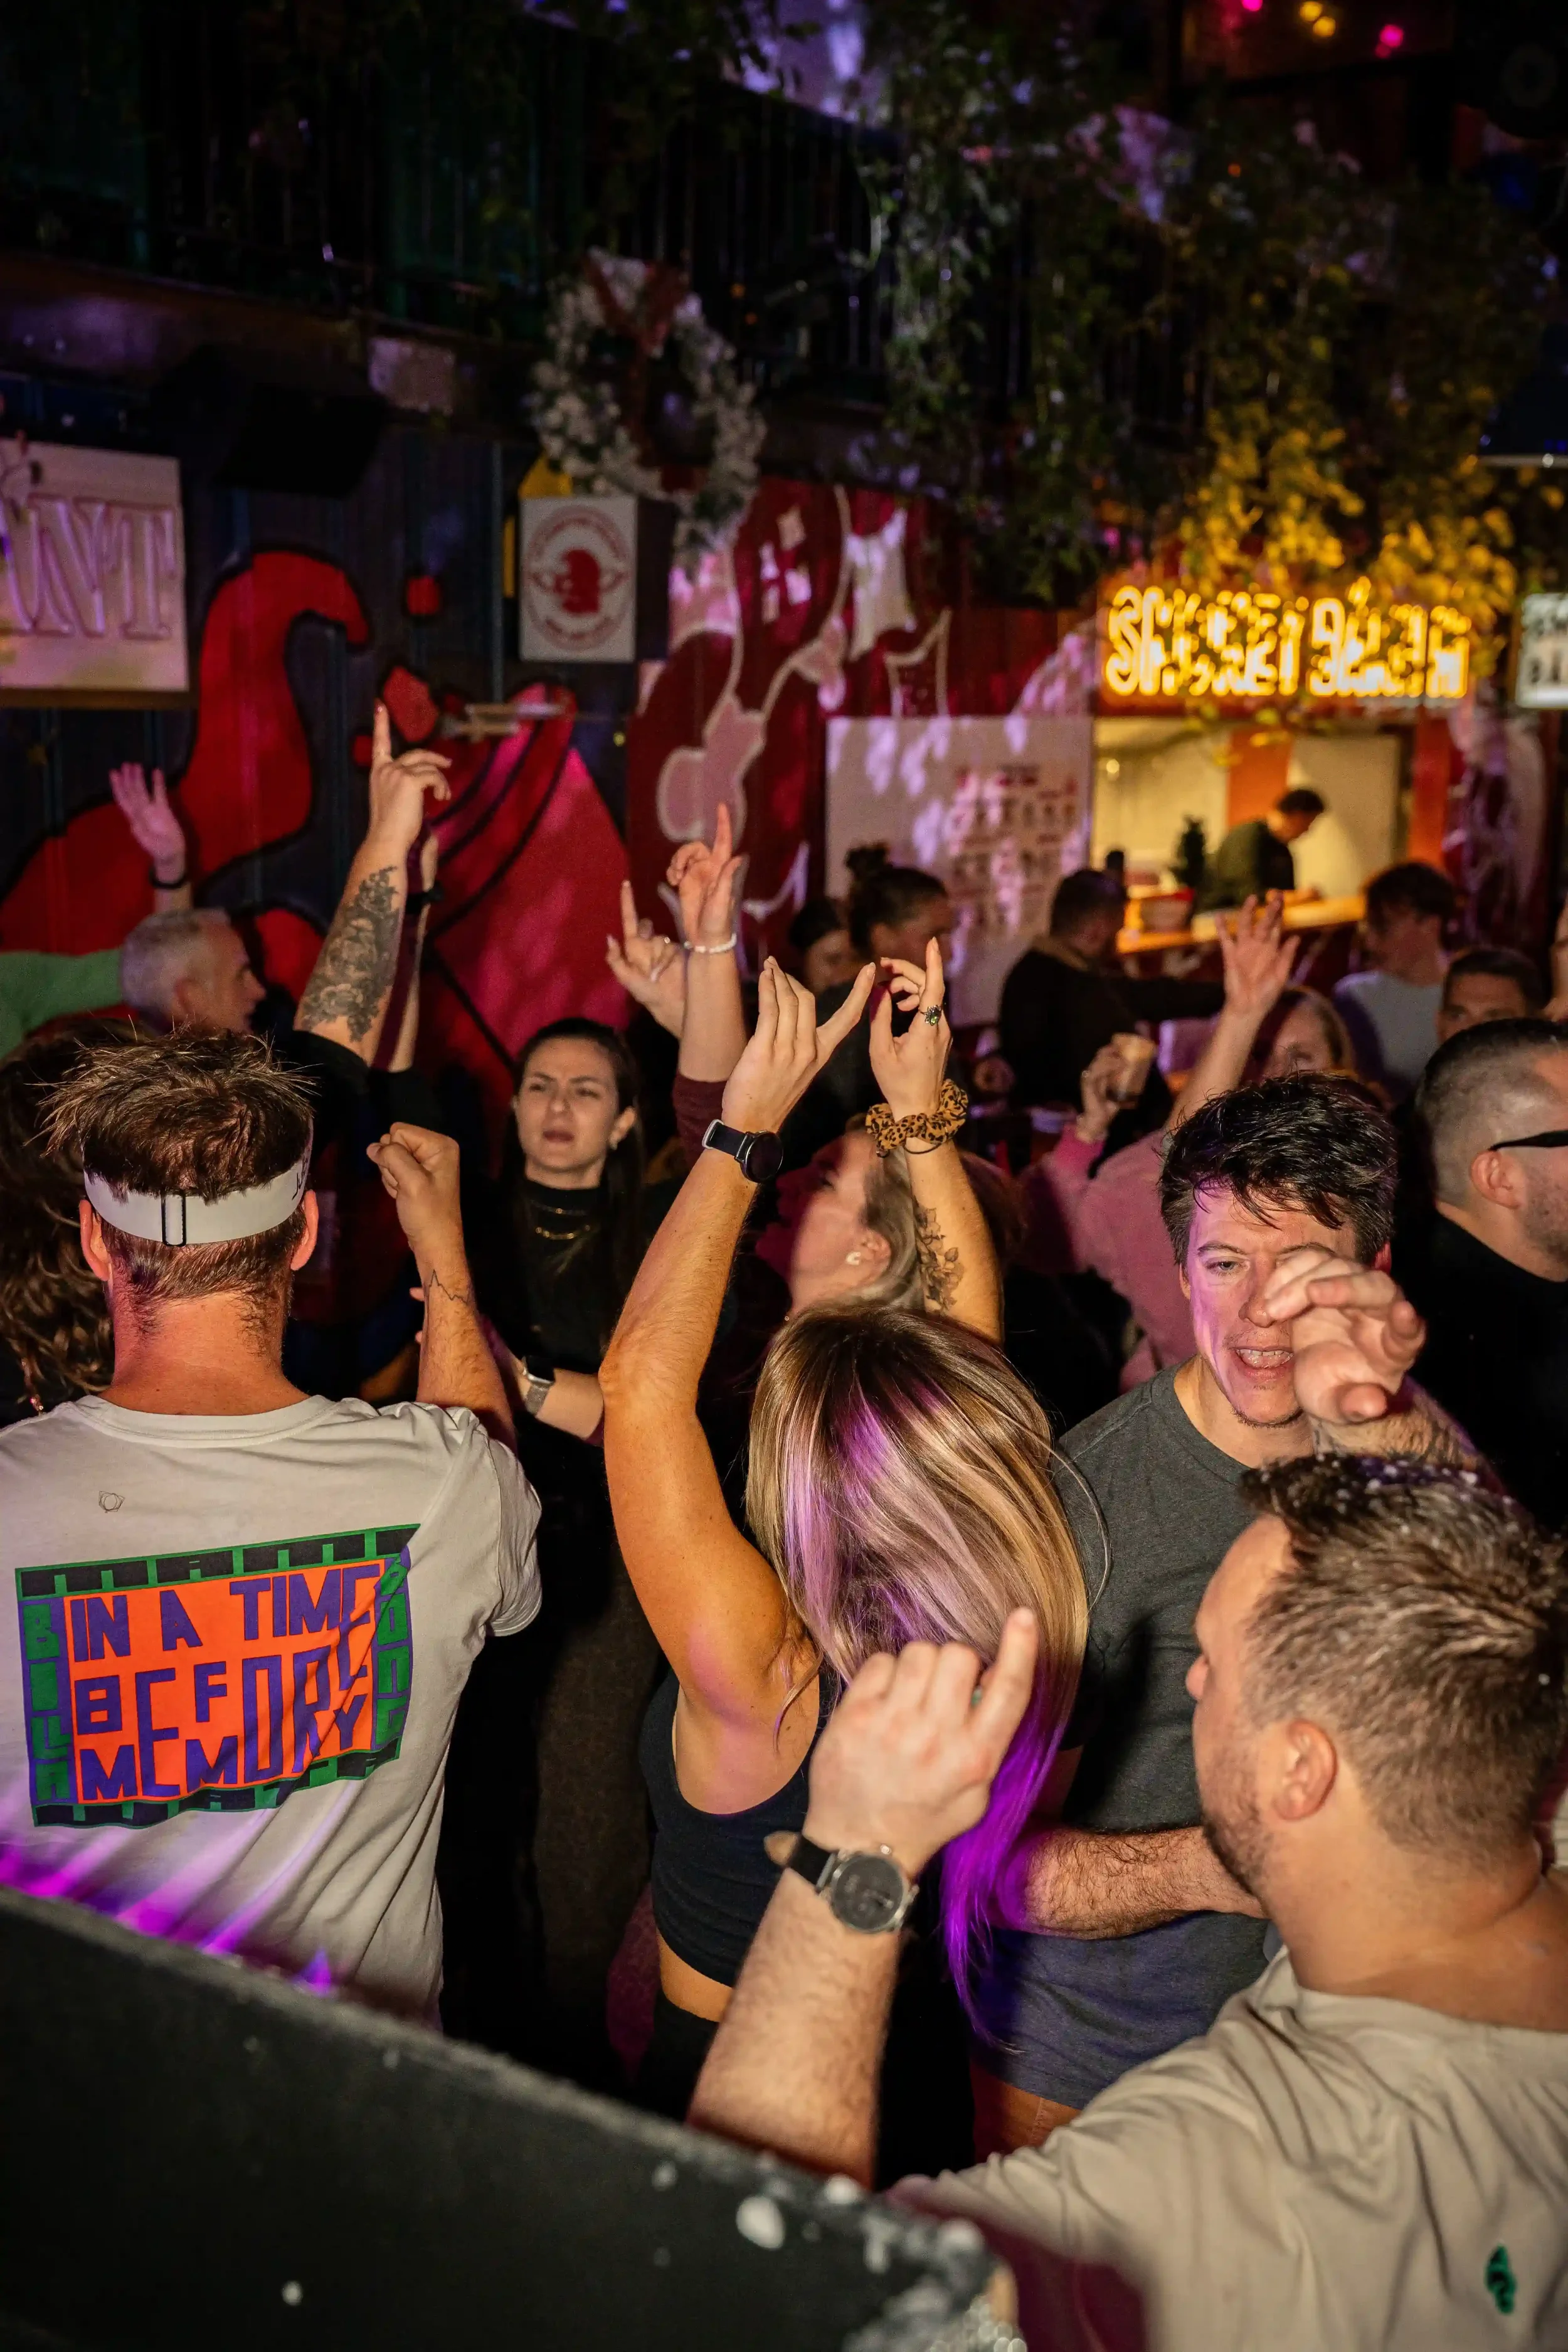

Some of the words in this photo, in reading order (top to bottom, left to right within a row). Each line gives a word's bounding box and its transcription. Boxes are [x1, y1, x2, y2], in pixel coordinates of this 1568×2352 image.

[70, 1595, 131, 1662] IN
[160, 1589, 203, 1652] A
[230, 1564, 380, 1668] TIME
